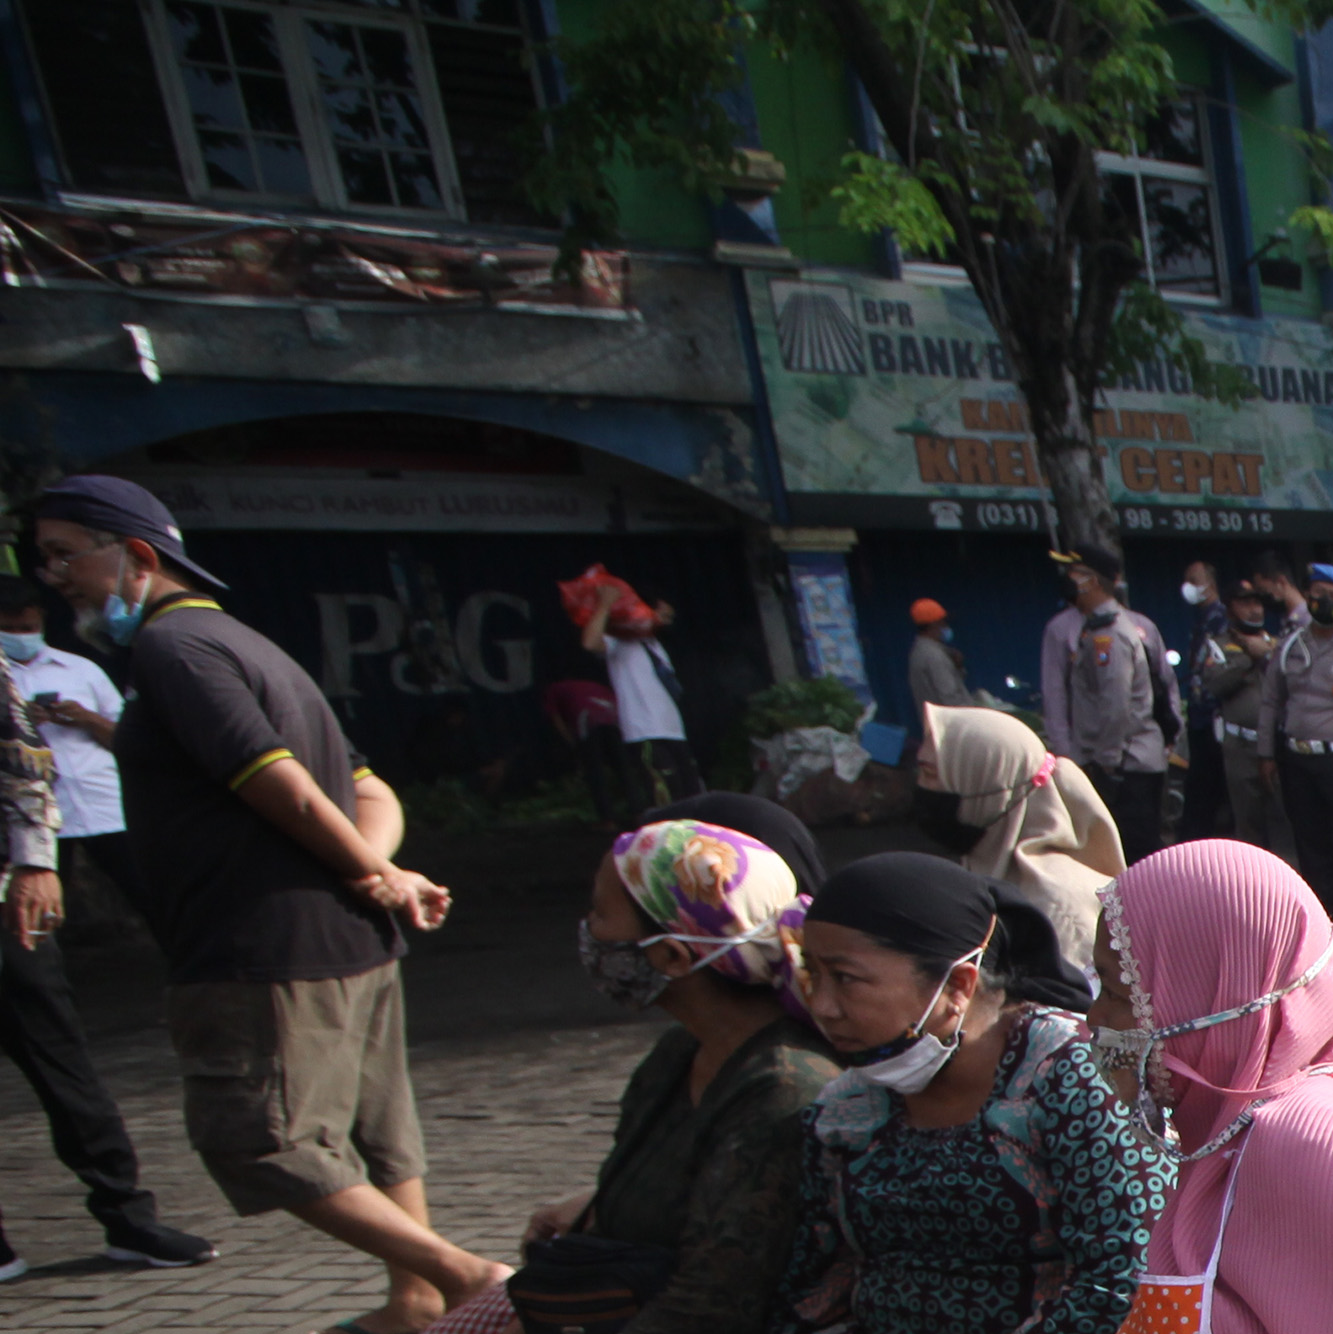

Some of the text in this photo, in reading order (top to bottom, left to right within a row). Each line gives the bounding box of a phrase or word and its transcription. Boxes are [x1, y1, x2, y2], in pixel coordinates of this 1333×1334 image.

[862, 298, 914, 327] BPR
[869, 332, 979, 380] BANK
[1120, 446, 1264, 498] CEPAT
[976, 502, 1039, 531] (031)
[1123, 507, 1154, 530] 98
[1172, 509, 1212, 532] 398
[1217, 511, 1243, 533] 30
[1249, 512, 1274, 534] 15
